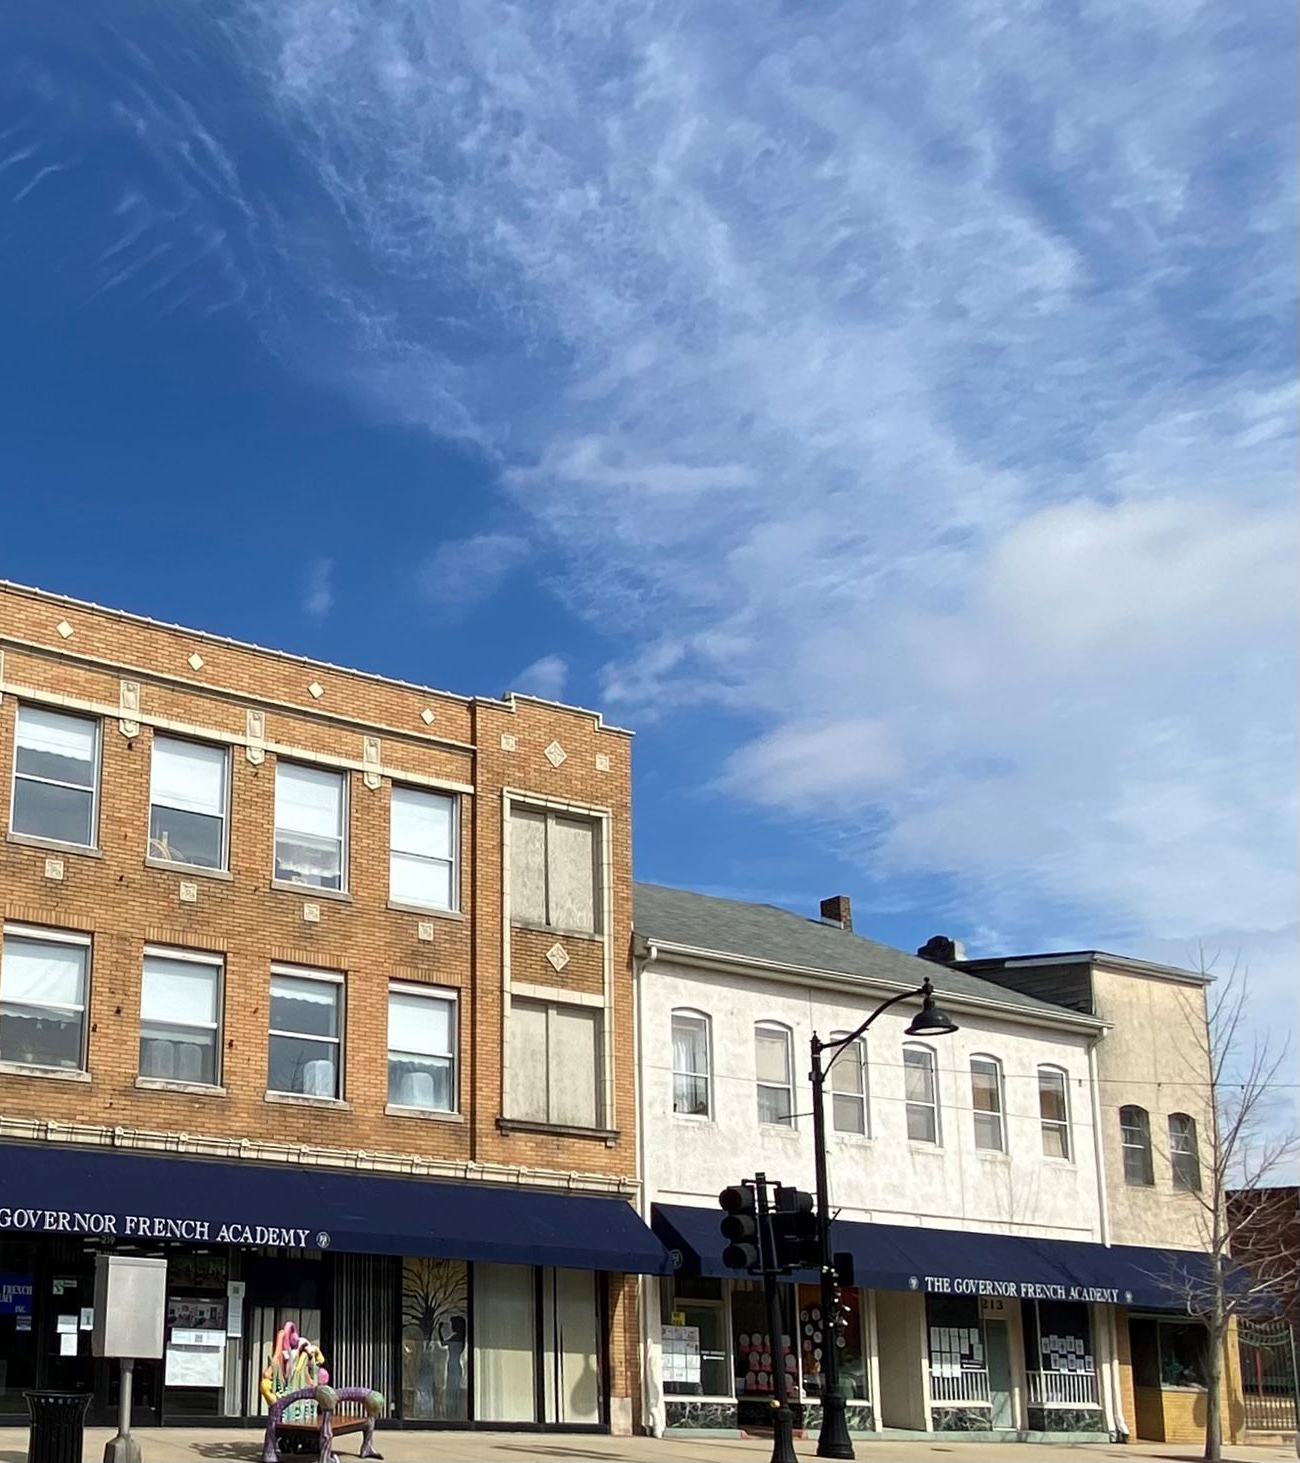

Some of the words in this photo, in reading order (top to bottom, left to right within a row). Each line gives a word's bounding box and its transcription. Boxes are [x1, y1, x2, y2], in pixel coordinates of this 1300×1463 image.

[124, 1215, 210, 1241] FRENCH
[216, 1223, 311, 1248] ACADEMY
[2, 1284, 33, 1295] FRENCH
[924, 1276, 951, 1293] THE
[954, 1278, 1019, 1298] GOVERNOR
[1020, 1282, 1067, 1300] FRENCH
[1068, 1286, 1119, 1304] ACADEMY
[981, 1298, 1004, 1310] 213
